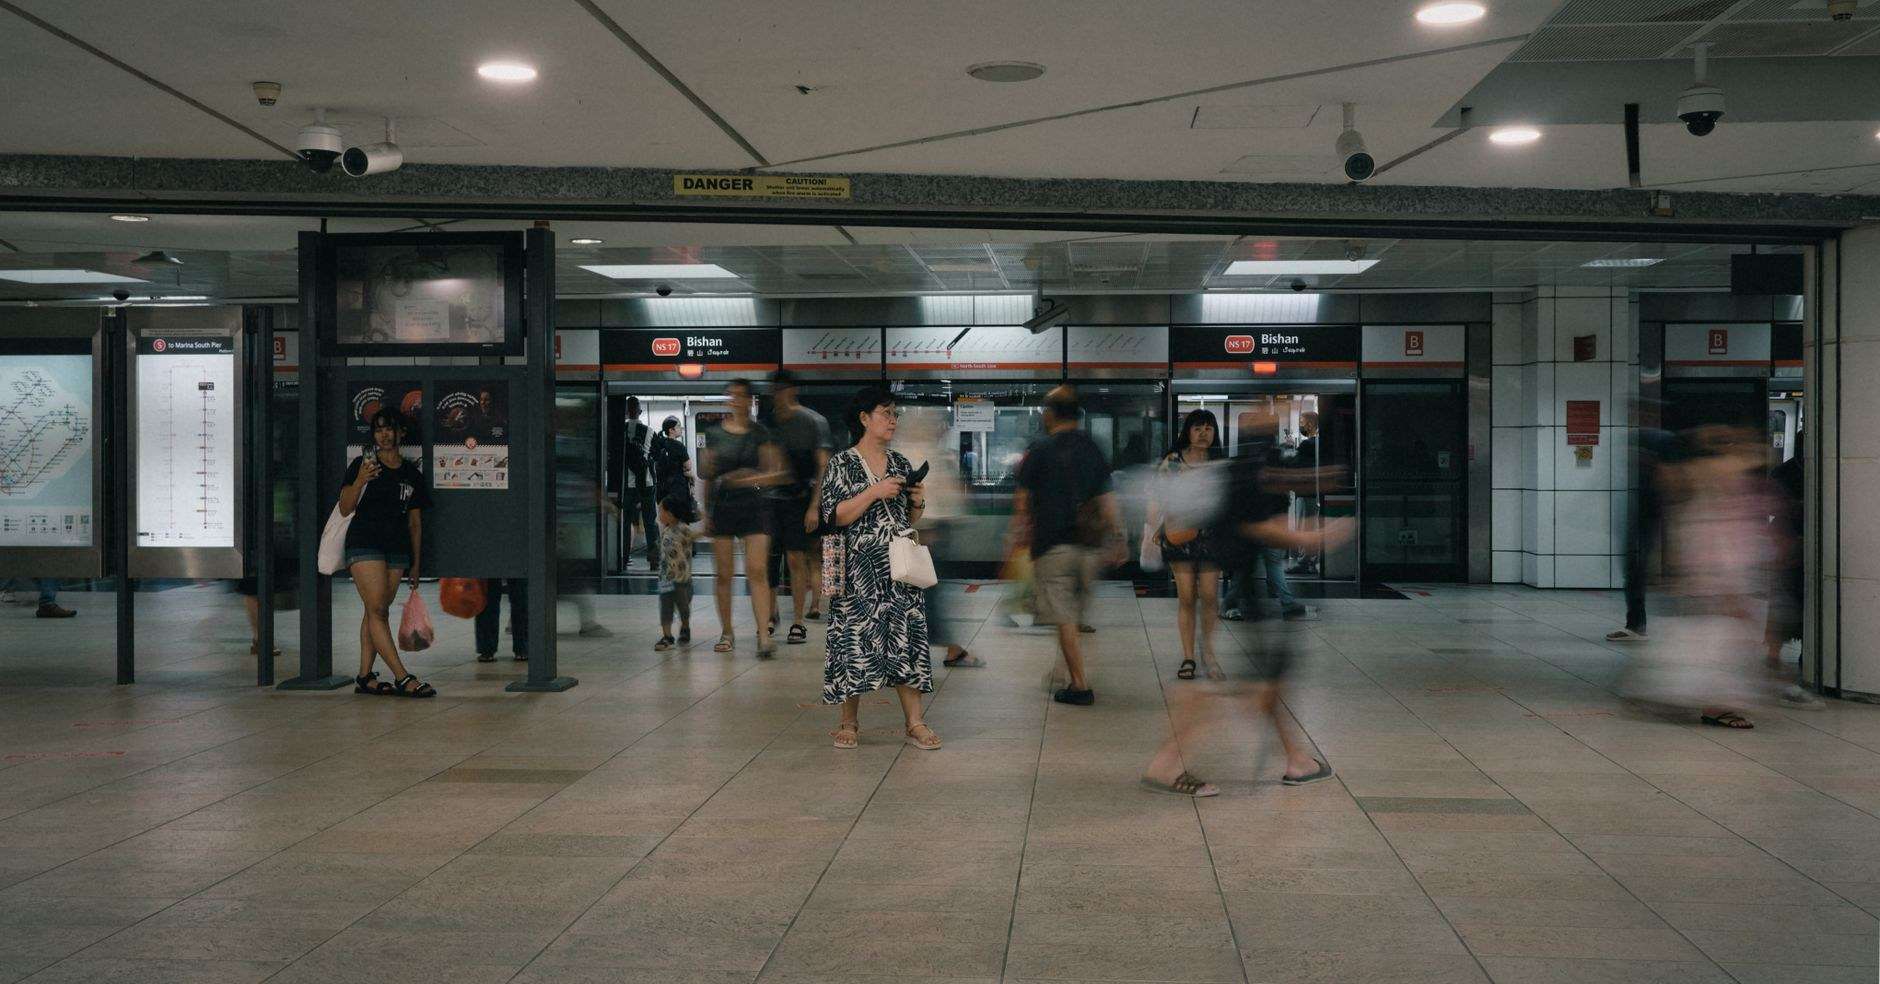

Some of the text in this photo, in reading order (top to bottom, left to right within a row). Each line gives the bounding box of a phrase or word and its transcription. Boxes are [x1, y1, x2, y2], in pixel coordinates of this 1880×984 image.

[683, 178, 754, 190] DANGER
[786, 178, 827, 186] CAUTION!
[687, 336, 722, 347] Bishan
[1228, 340, 1251, 348] NS 17
[1261, 333, 1299, 344] Bishan
[1410, 335, 1419, 348] B
[1714, 333, 1722, 347] B
[175, 341, 194, 349] Marina
[194, 341, 210, 349] South
[211, 341, 222, 349] Pier
[274, 341, 282, 353] B
[656, 343, 677, 351] NS 17
